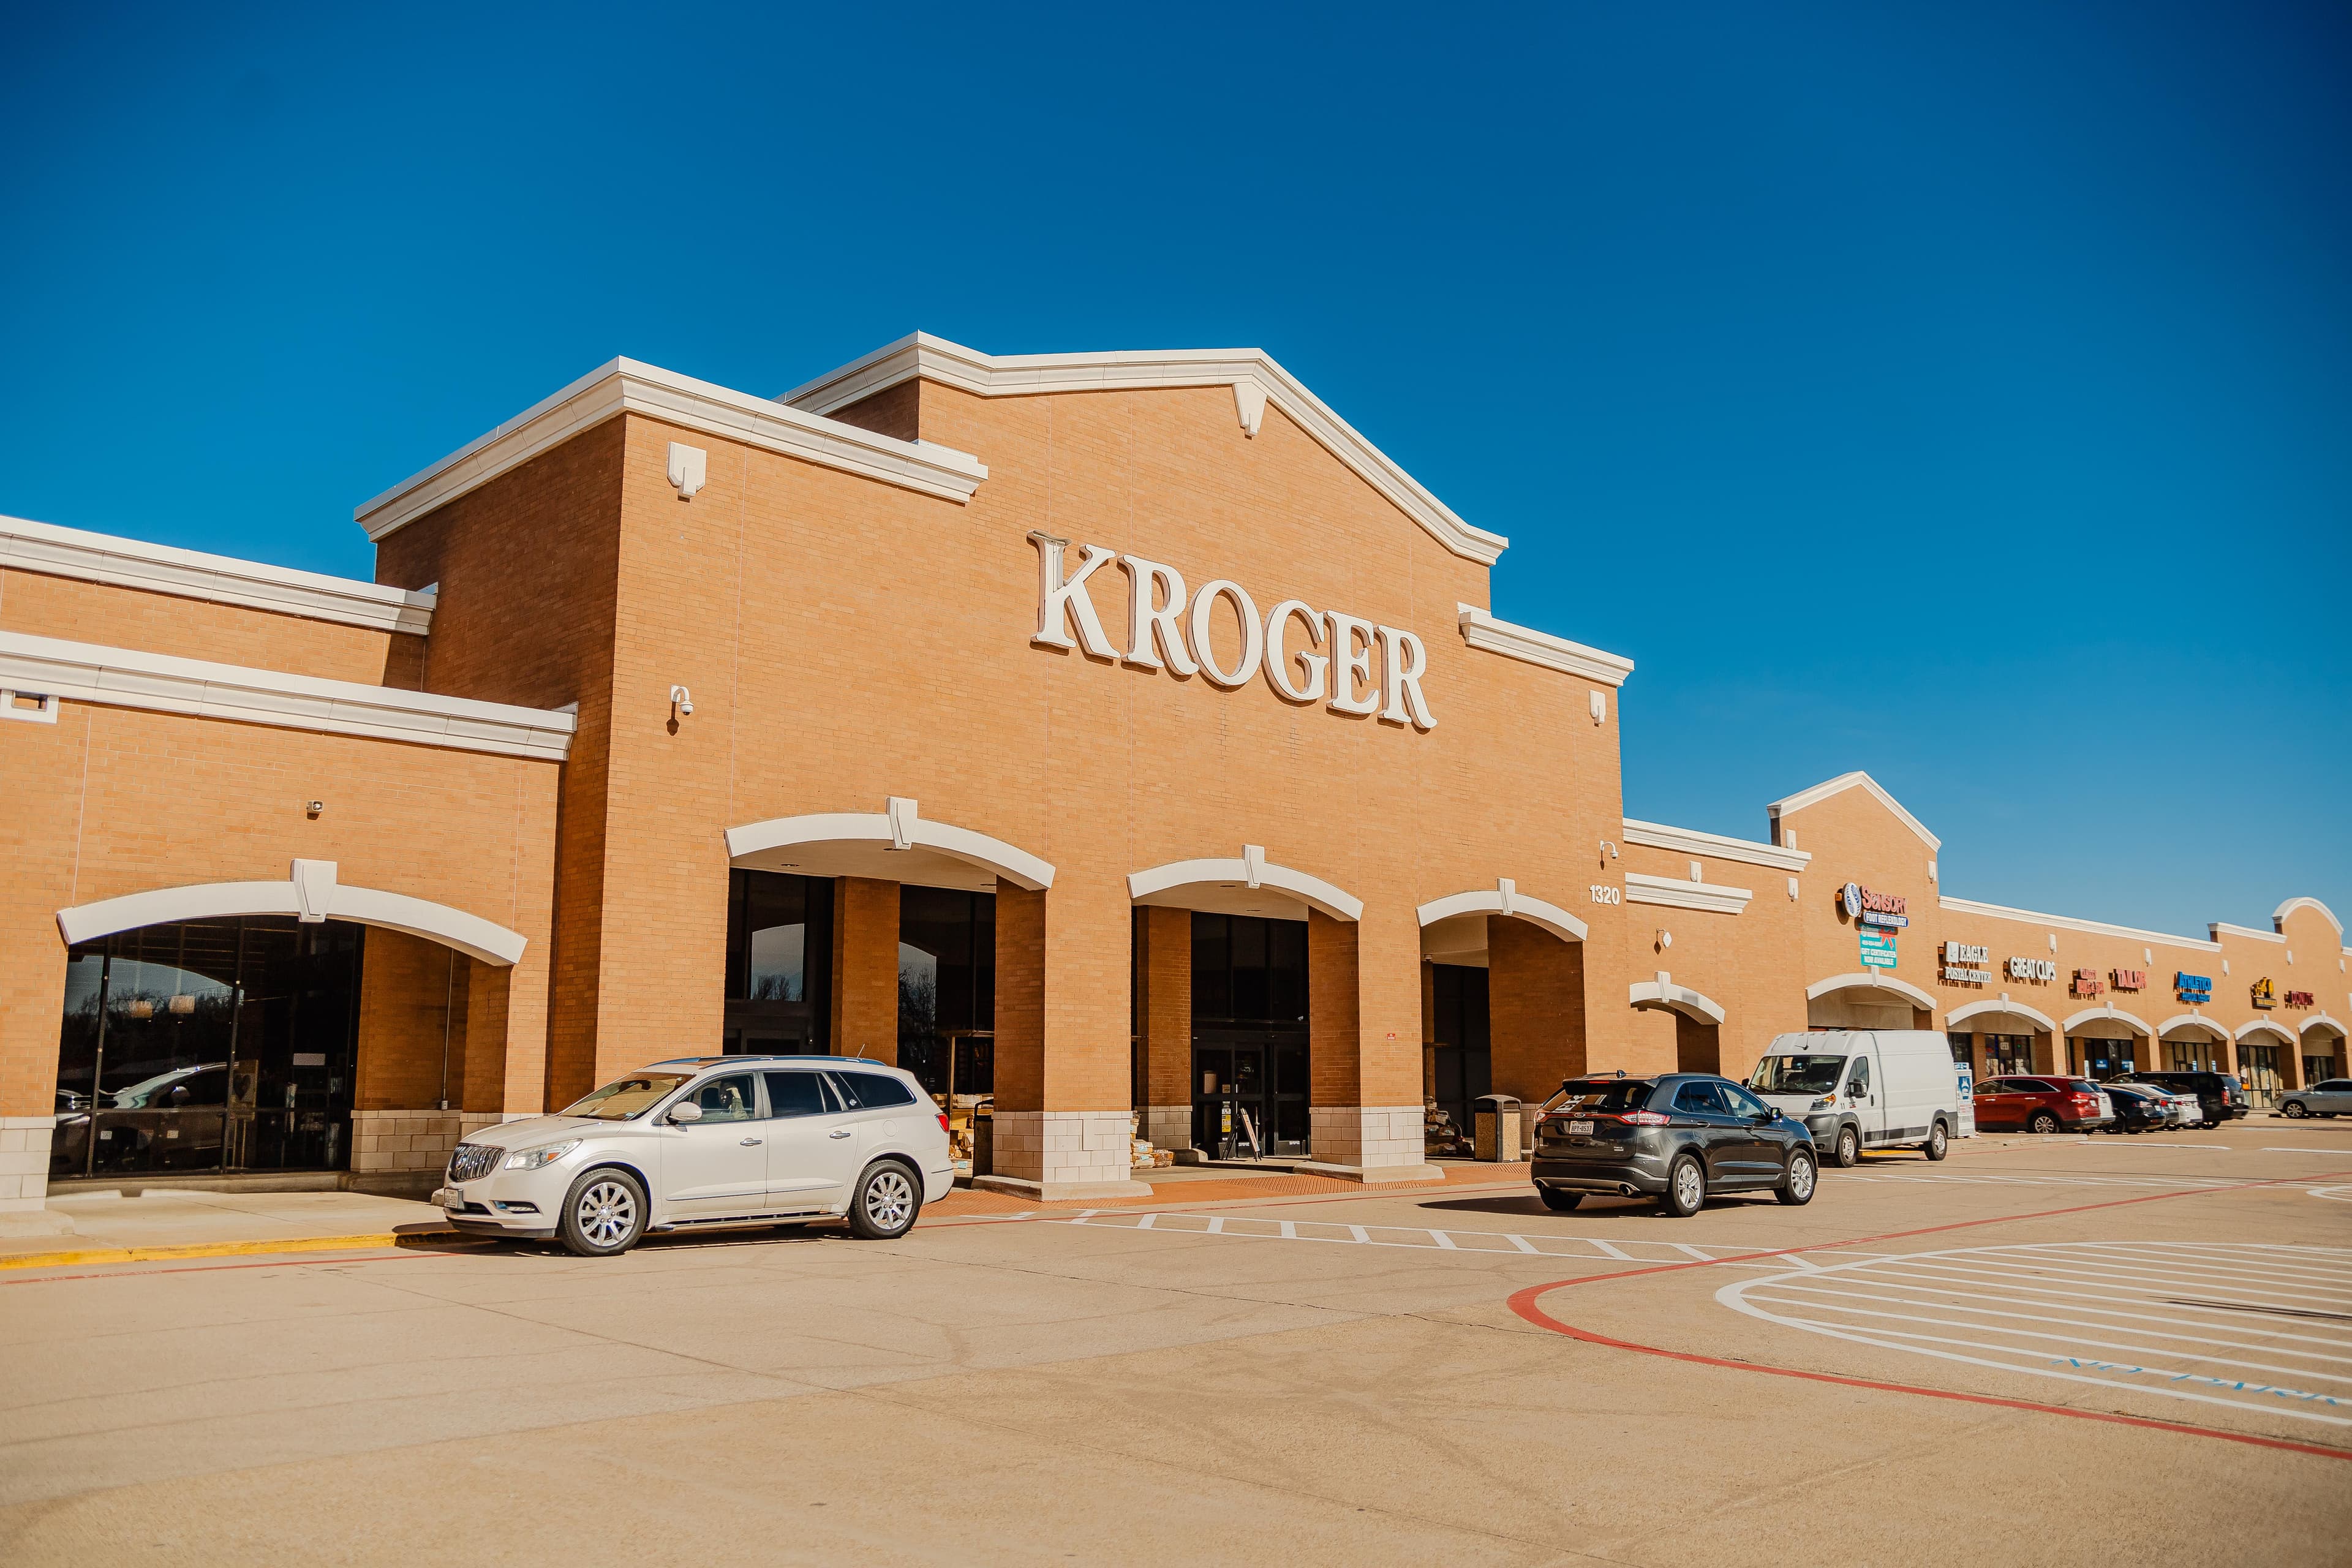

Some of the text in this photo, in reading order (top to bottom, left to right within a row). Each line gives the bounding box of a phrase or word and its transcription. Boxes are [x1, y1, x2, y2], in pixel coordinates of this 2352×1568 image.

[1027, 529, 1438, 731] KROGER
[1589, 884, 1620, 905] 1320
[1959, 944, 1989, 963] EAGLE
[1945, 966, 1992, 983] POSTAL CENTER
[2010, 956, 2056, 981] GREAT CLIPS
[2116, 968, 2147, 989] TAILOR
[2291, 990, 2314, 1006] DONUTS
[2048, 1358, 2143, 1373] NO
